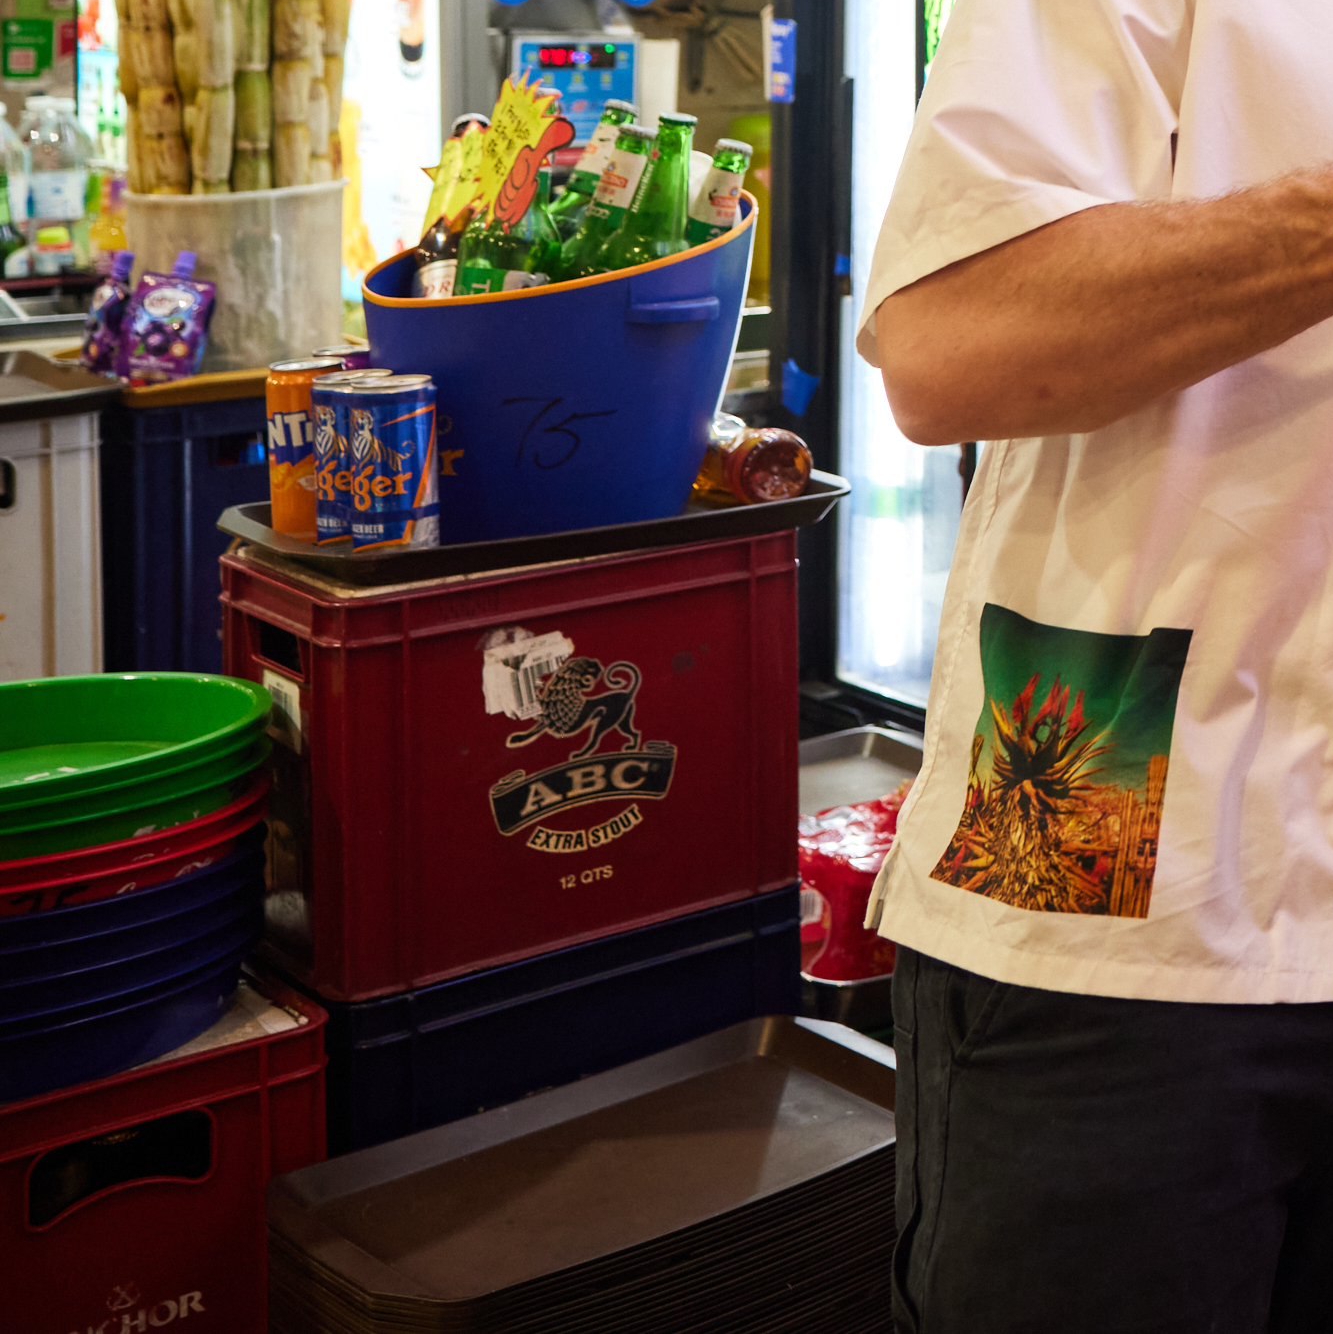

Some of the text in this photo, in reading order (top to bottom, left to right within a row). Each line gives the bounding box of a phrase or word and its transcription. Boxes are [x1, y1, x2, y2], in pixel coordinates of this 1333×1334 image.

[500, 396, 620, 468] 75
[520, 760, 650, 817] ABC
[529, 806, 642, 850] EXTRA STOUT
[559, 864, 614, 890] 12 QTS
